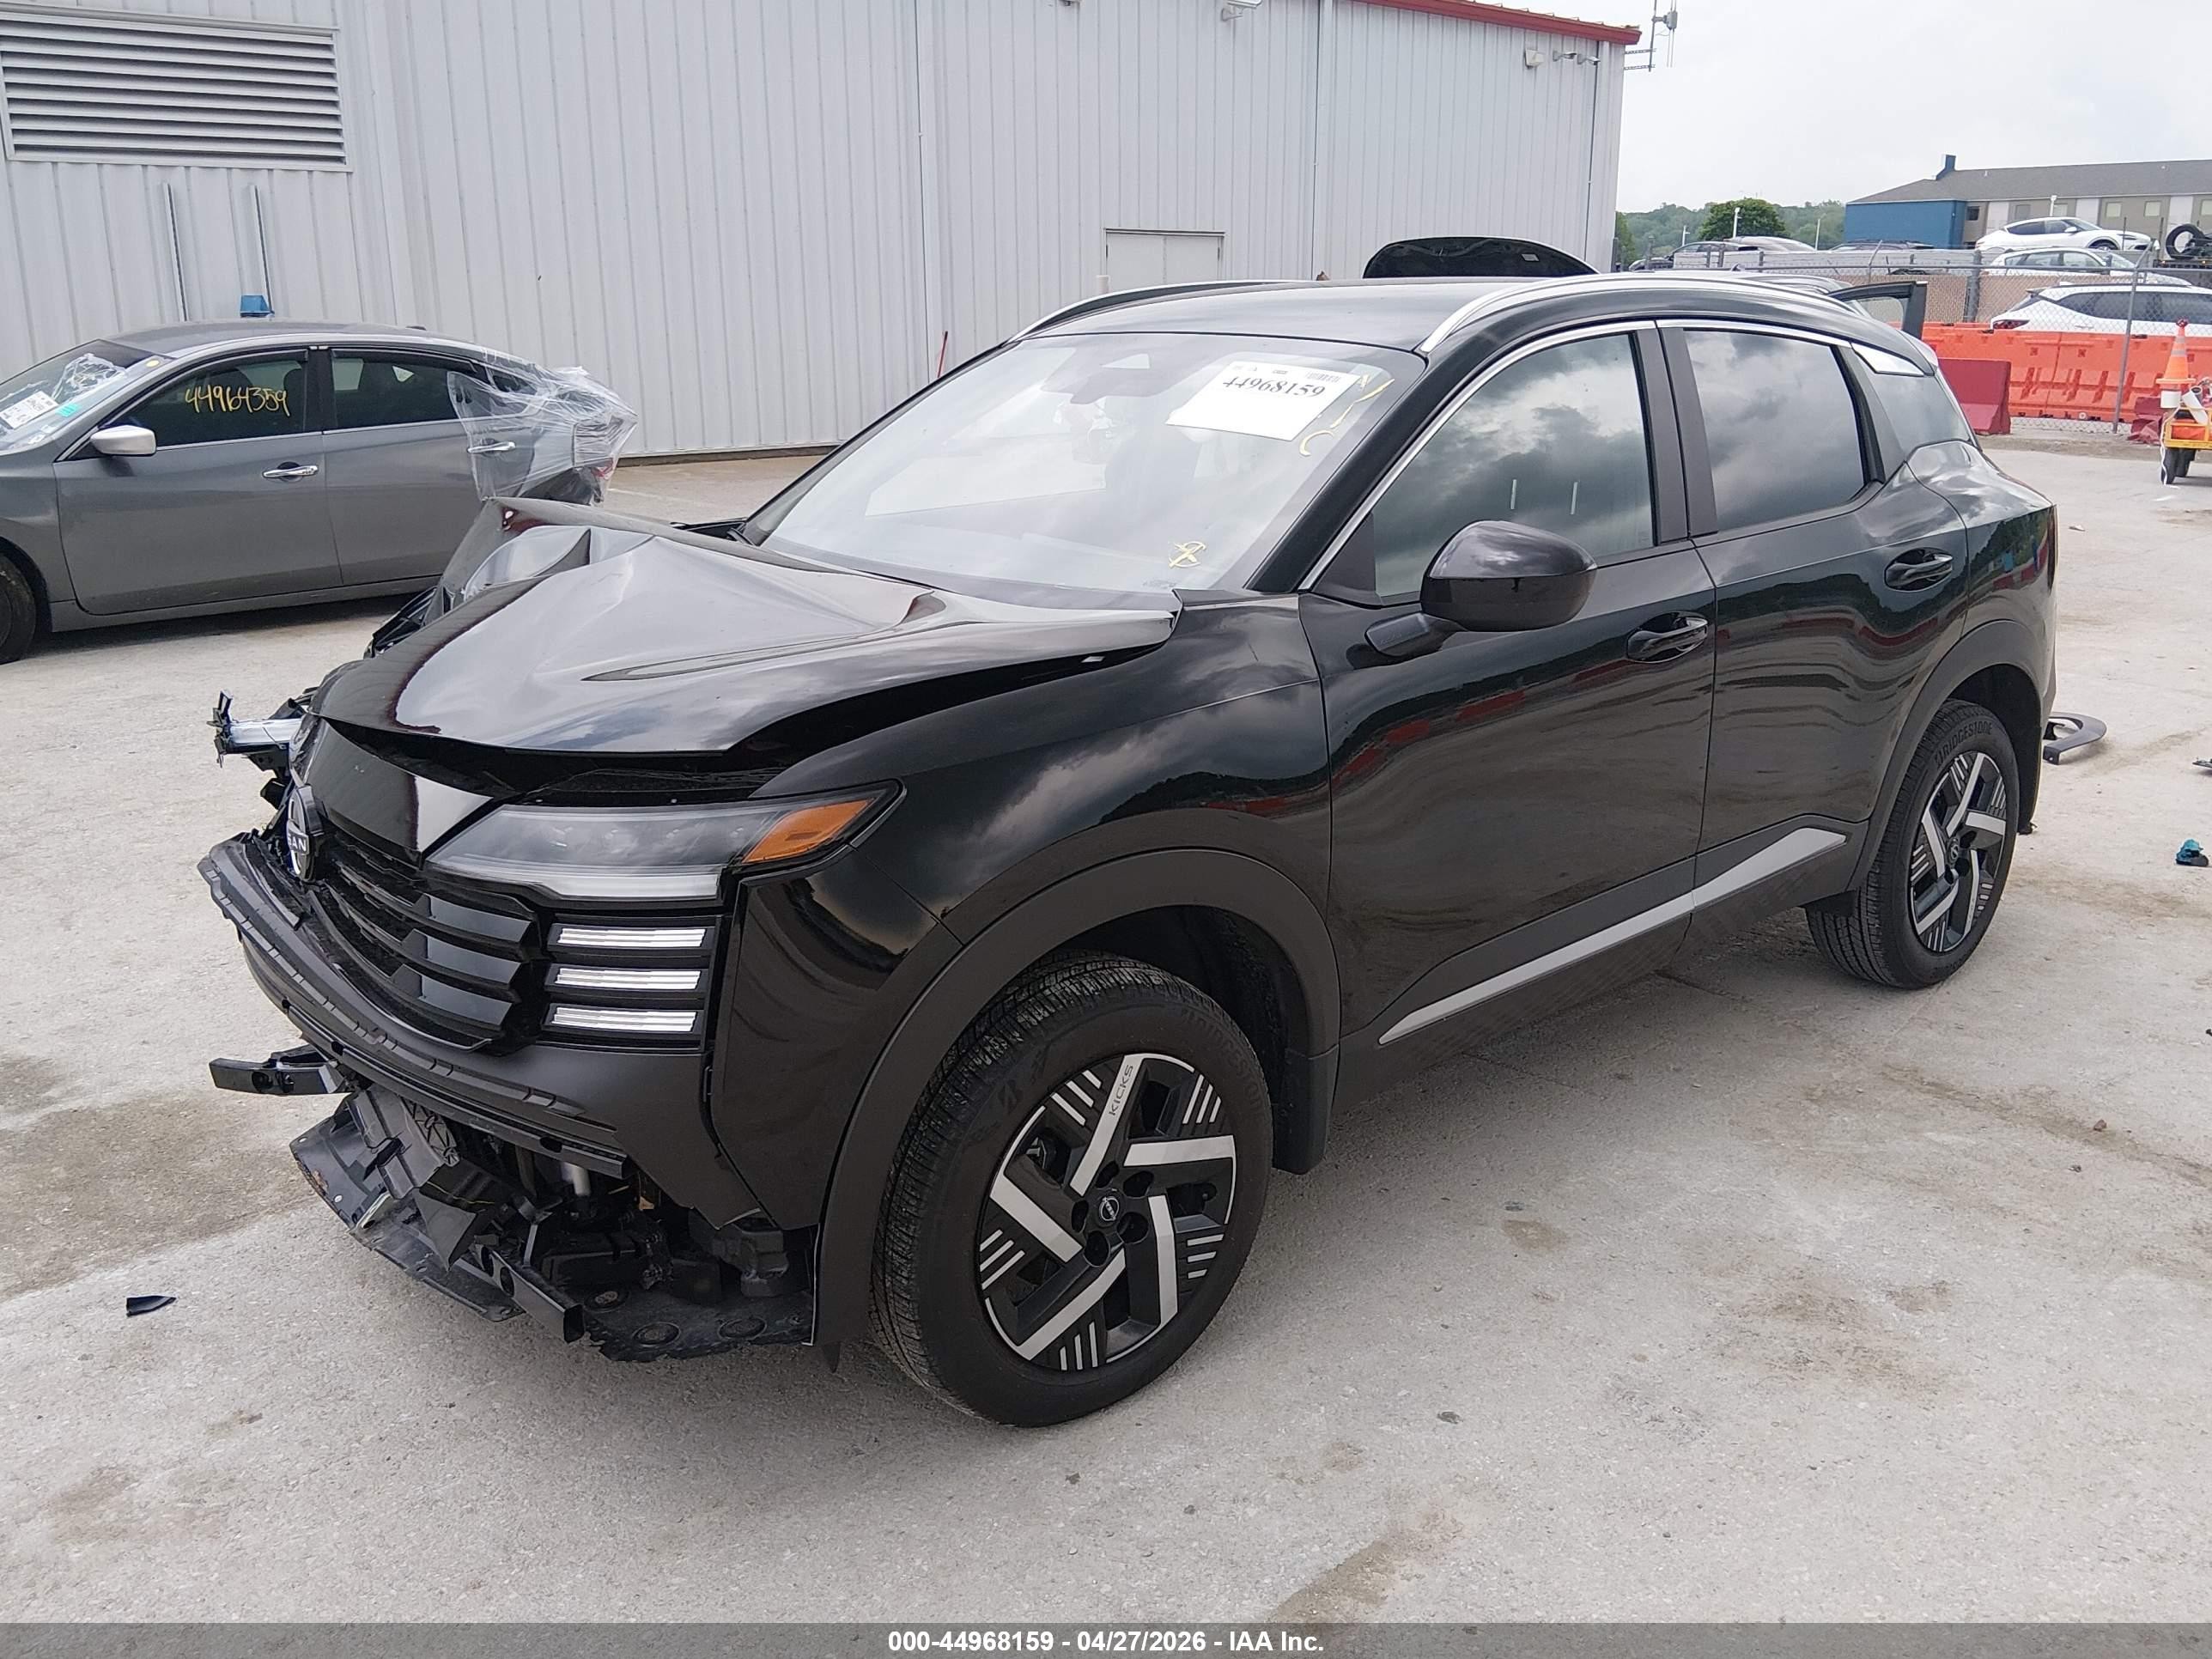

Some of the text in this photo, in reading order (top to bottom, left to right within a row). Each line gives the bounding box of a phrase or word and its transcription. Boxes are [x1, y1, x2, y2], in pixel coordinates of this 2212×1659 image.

[185, 384, 290, 416] 44964359
[1223, 376, 1326, 398] 44968159
[1109, 1064, 1133, 1116] KICKS
